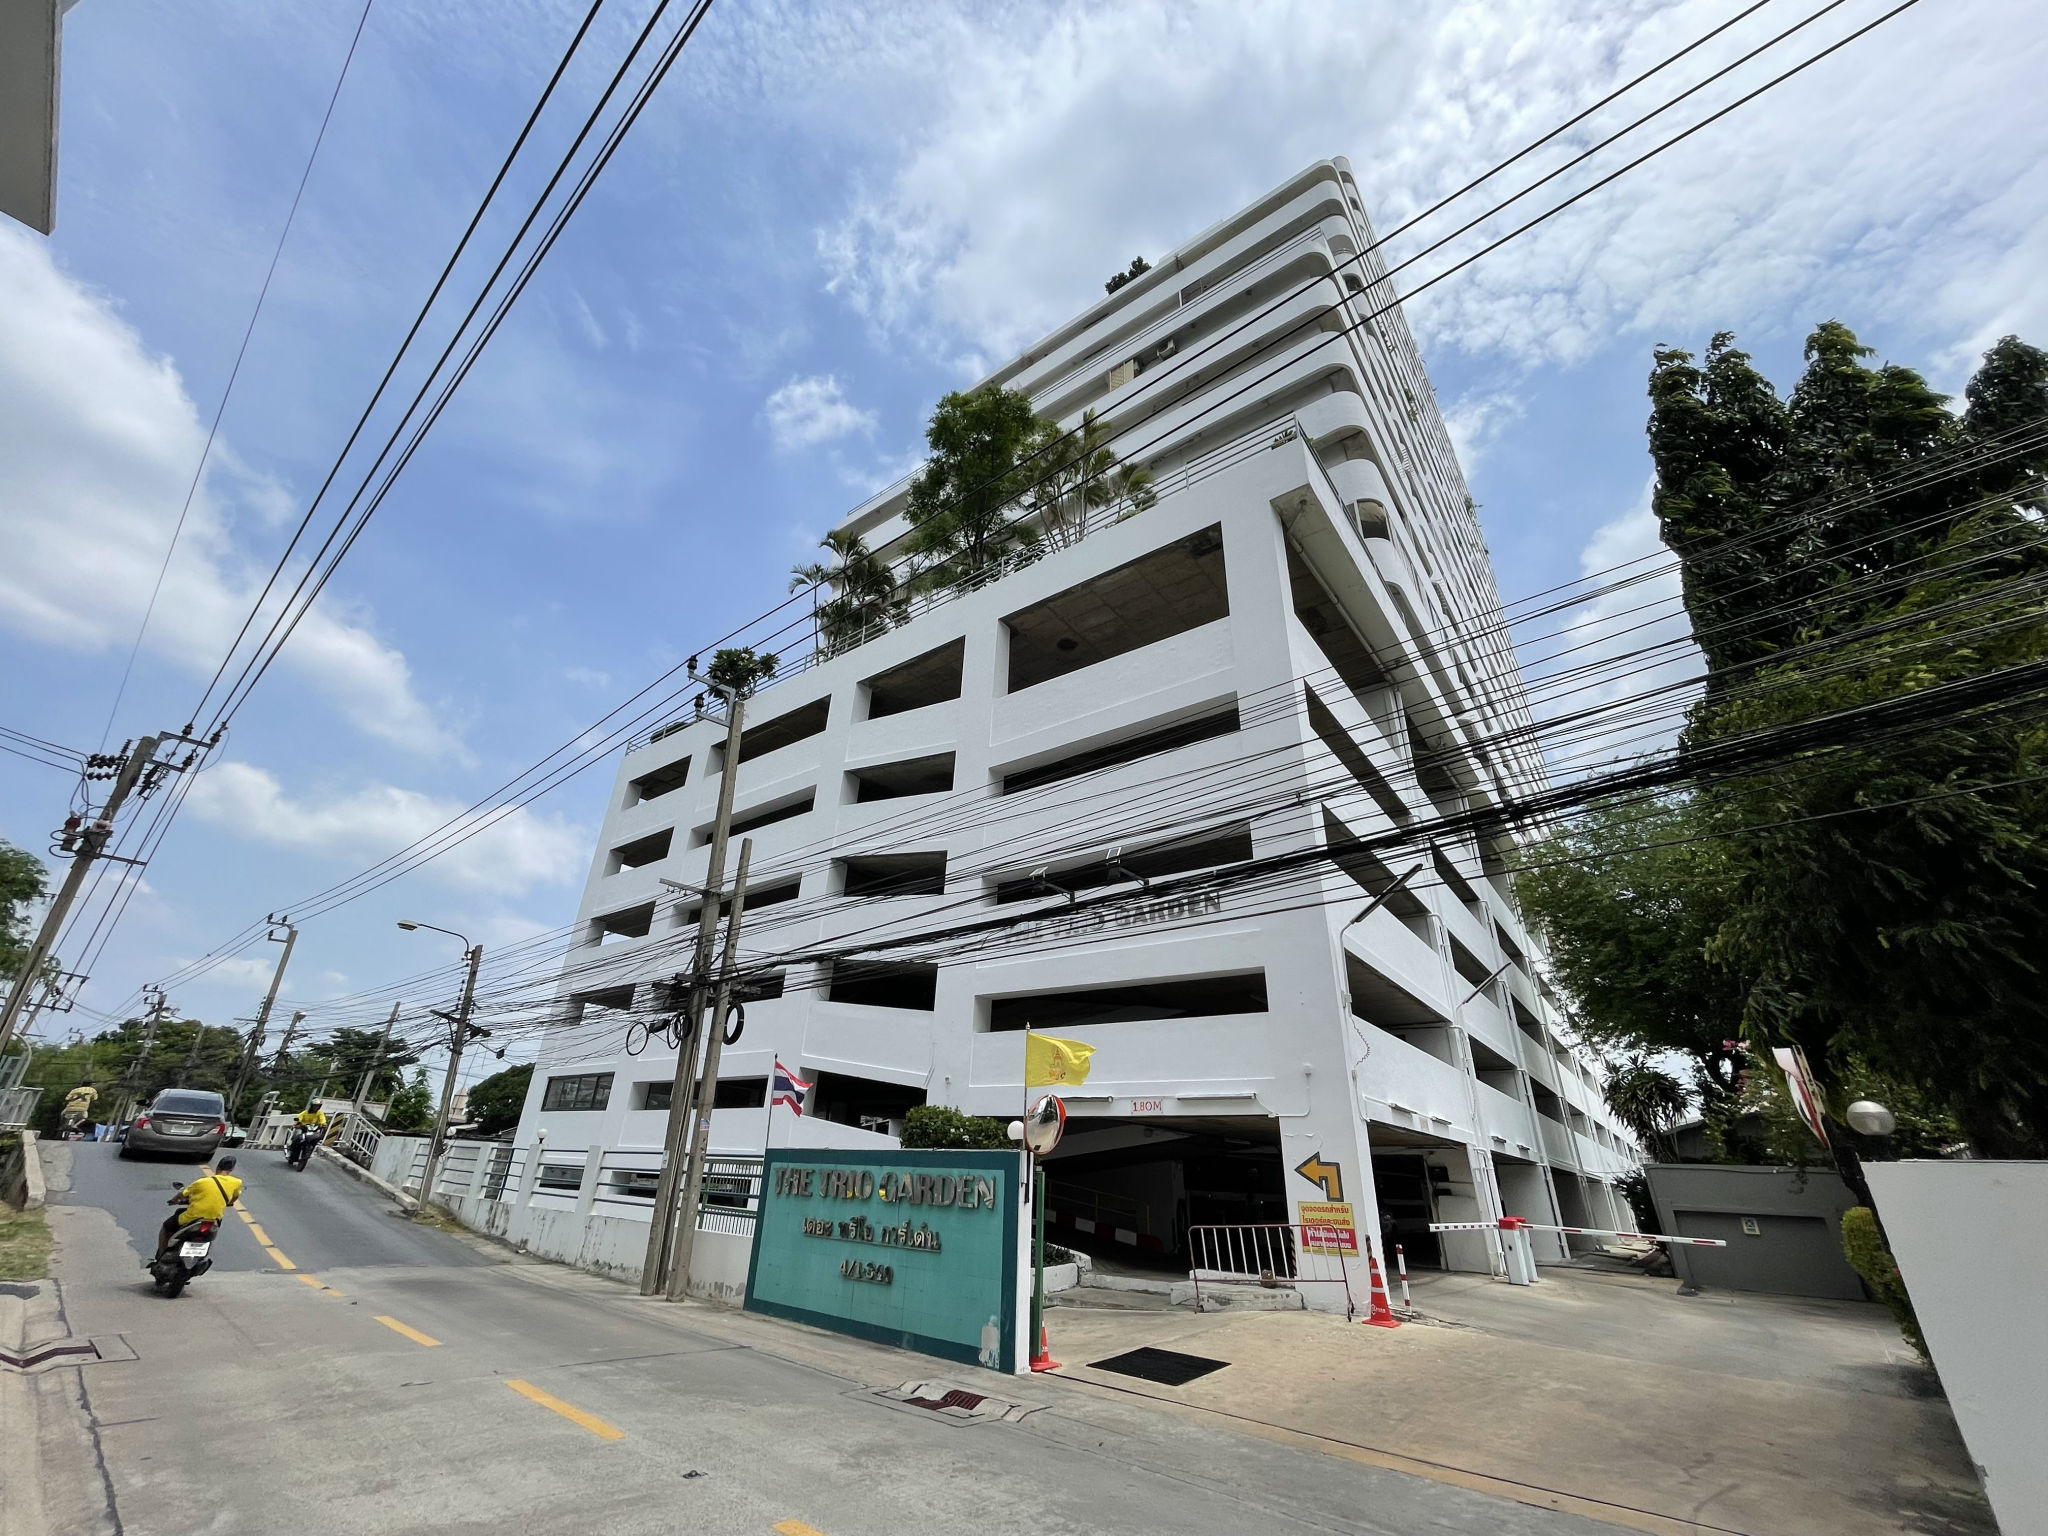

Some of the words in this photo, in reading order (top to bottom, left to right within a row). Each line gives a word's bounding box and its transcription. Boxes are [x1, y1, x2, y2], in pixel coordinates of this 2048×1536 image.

[1116, 891, 1220, 926] GARDEN
[775, 1167, 815, 1198] THE
[819, 1169, 875, 1200] TRIO
[878, 1171, 996, 1210] GARDEN
[803, 1217, 834, 1237] เดอะ
